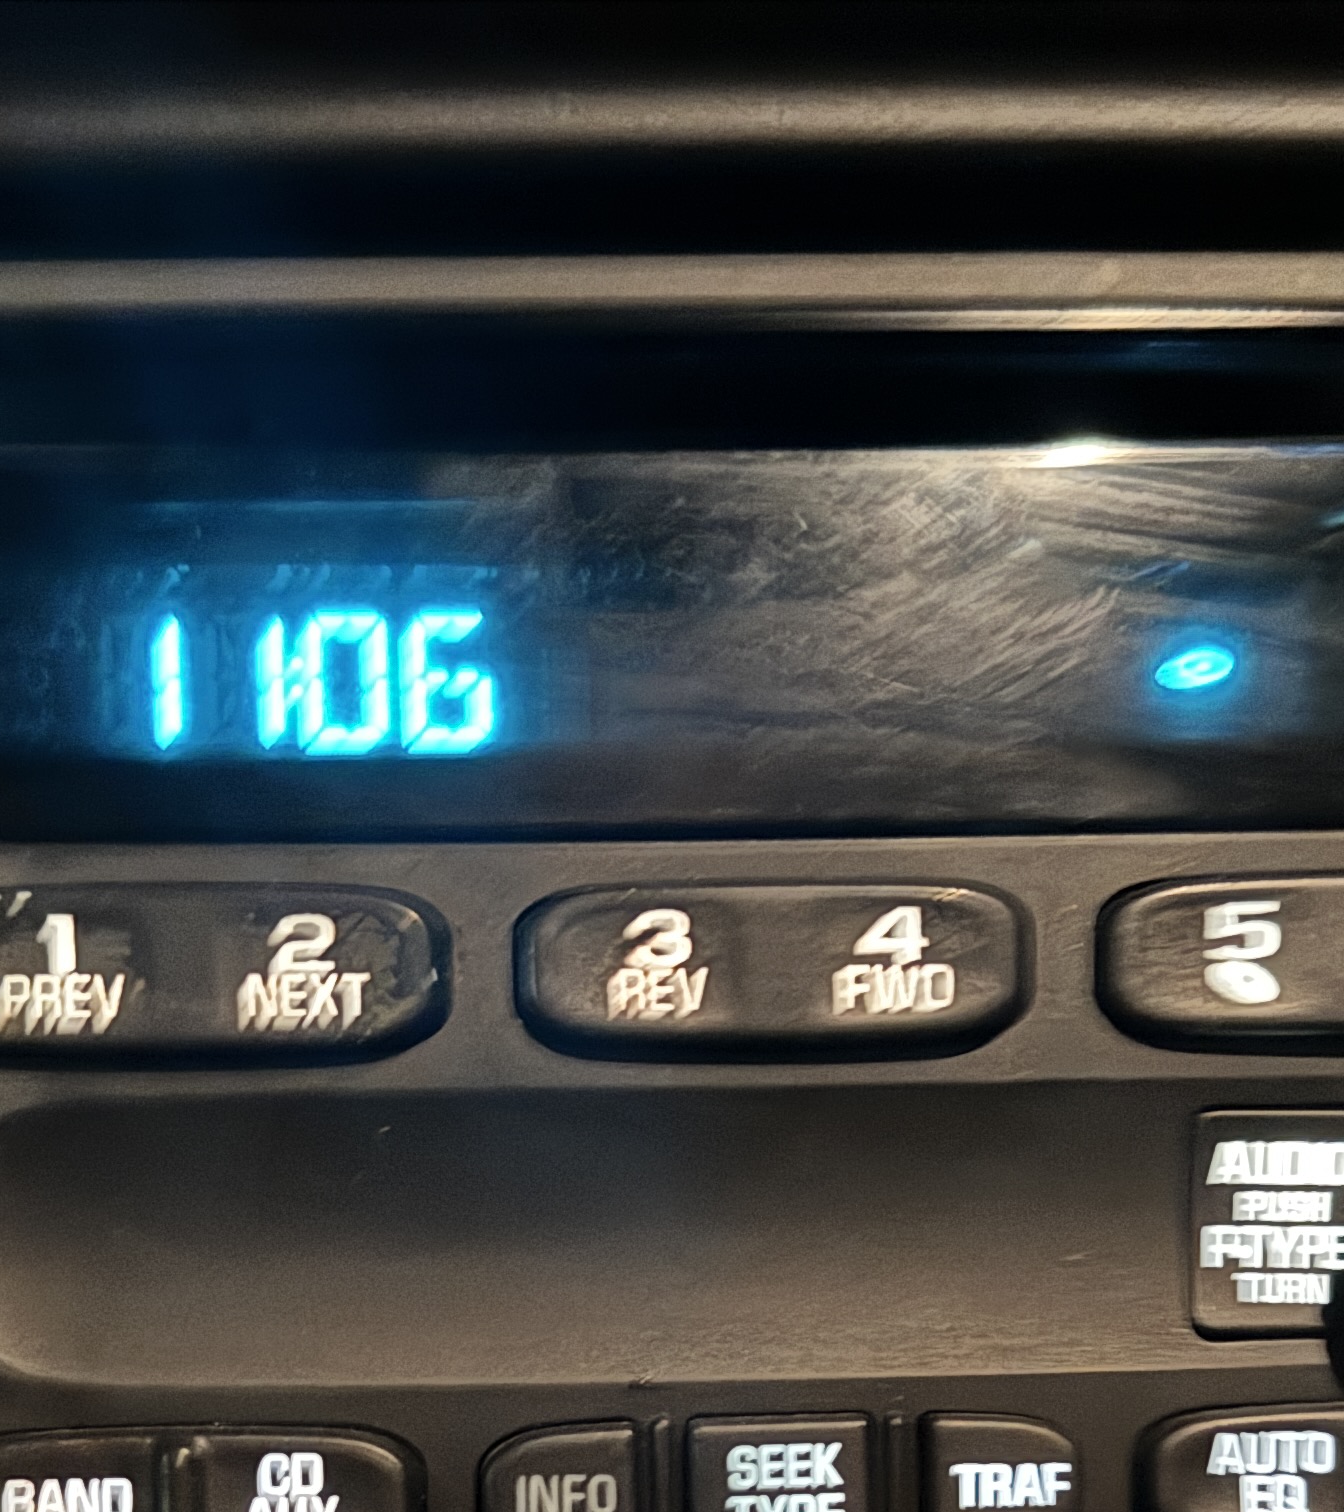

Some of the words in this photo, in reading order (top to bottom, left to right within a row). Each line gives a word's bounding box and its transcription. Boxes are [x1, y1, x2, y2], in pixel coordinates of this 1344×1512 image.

[35, 913, 77, 973] 1
[268, 913, 337, 972] 2
[623, 909, 692, 968] 3
[853, 906, 930, 965] 4
[1203, 900, 1282, 959] 5
[237, 972, 371, 1032] NEXT
[606, 967, 710, 1019] REV
[832, 963, 955, 1015] FWD
[257, 1452, 324, 1497] CD
[726, 1442, 844, 1492] SEEK
[1206, 1431, 1337, 1475] AUTO
[949, 1462, 1072, 1510] TRAF
